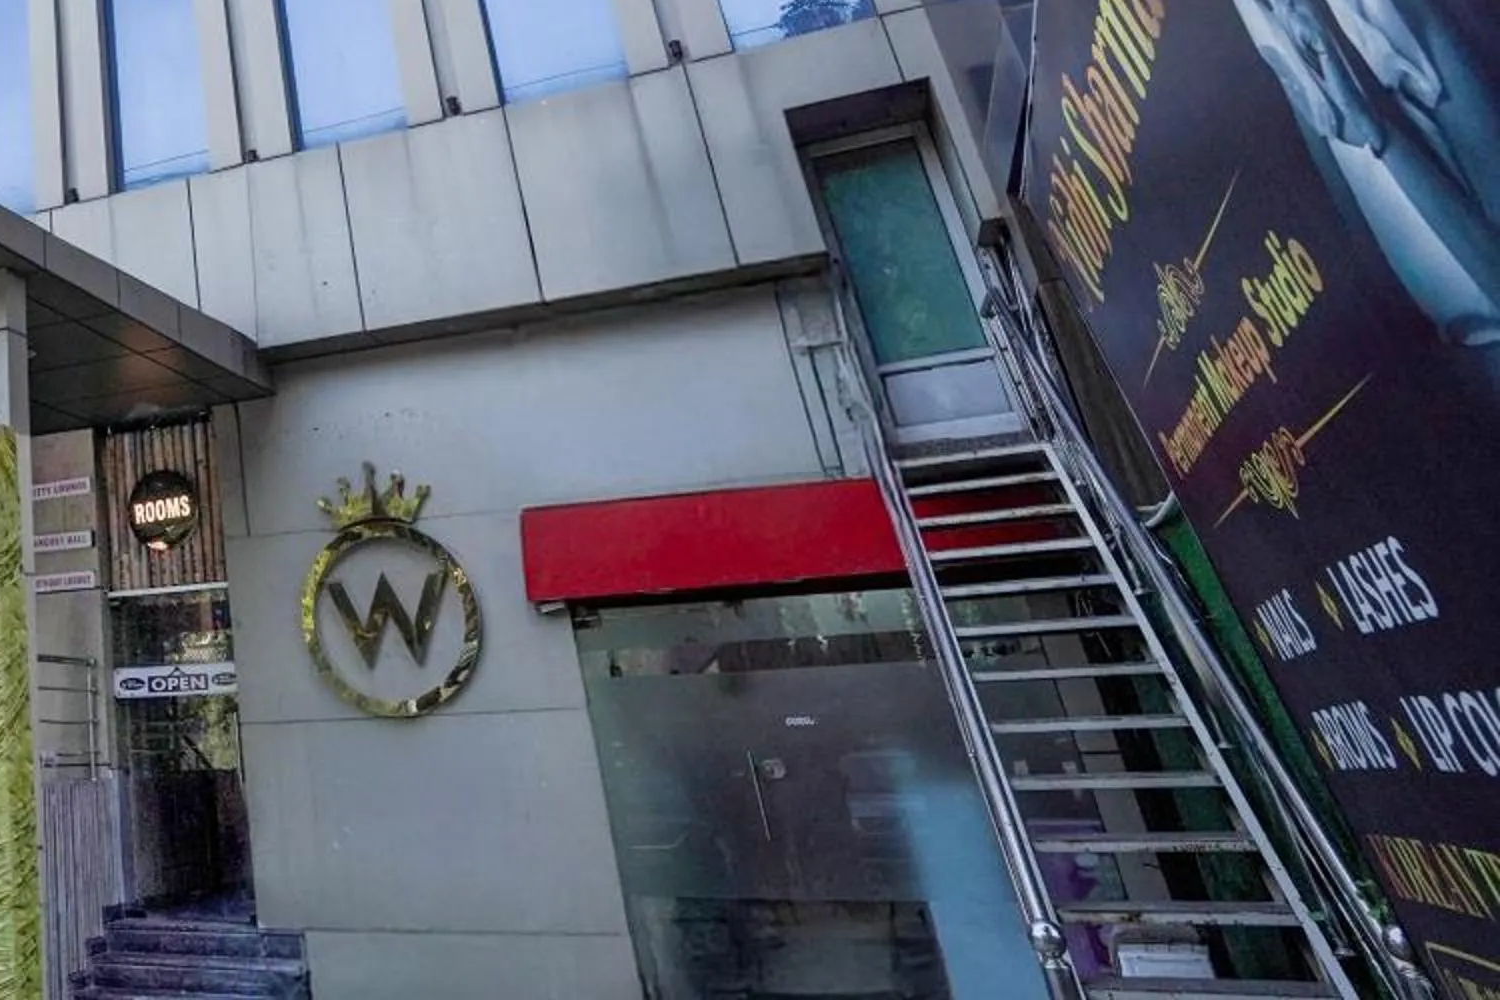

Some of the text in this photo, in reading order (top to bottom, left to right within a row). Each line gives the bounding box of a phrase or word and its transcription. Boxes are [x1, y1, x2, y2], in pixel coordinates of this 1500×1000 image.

[1196, 315, 1278, 414] Makeup
[1241, 230, 1323, 347] Studio
[134, 495, 192, 525] ROOMS
[327, 568, 447, 671] W
[1326, 535, 1440, 635] LASHES
[1255, 587, 1318, 662] NAILS
[151, 674, 206, 692] OPEN
[1310, 700, 1398, 771] BROWS
[1399, 695, 1466, 773] LIP
